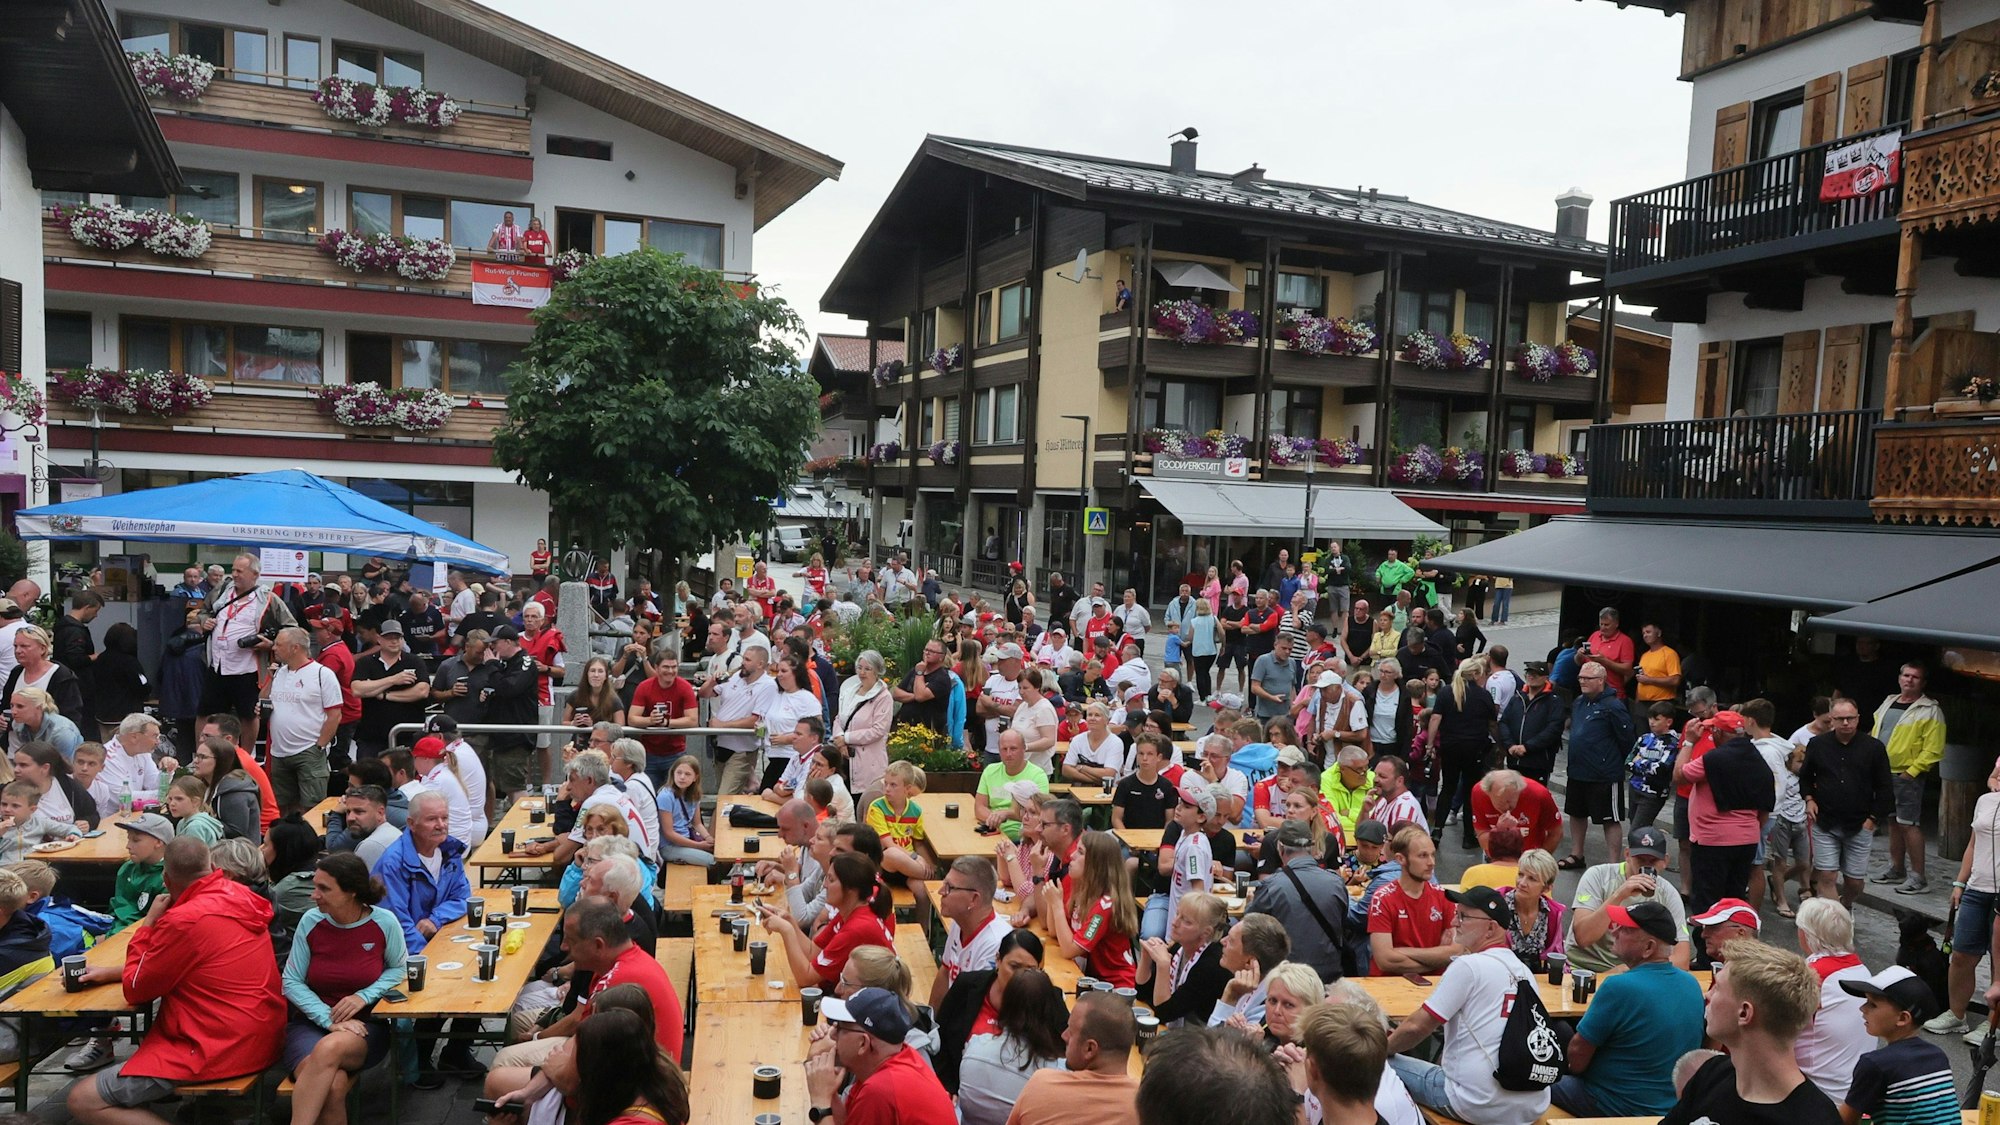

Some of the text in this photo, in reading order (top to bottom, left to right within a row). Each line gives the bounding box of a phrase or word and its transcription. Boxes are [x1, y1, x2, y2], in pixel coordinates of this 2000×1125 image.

[1158, 459, 1221, 471] FOODWERKSTATT
[111, 519, 176, 533] Weihenstephan
[232, 526, 355, 542] URSPRUNG DES BIERES
[410, 625, 434, 635] REWE
[1086, 916, 1101, 938] DEVK
[1532, 1063, 1559, 1077] IMMER
[1528, 1072, 1557, 1084] DABEI
